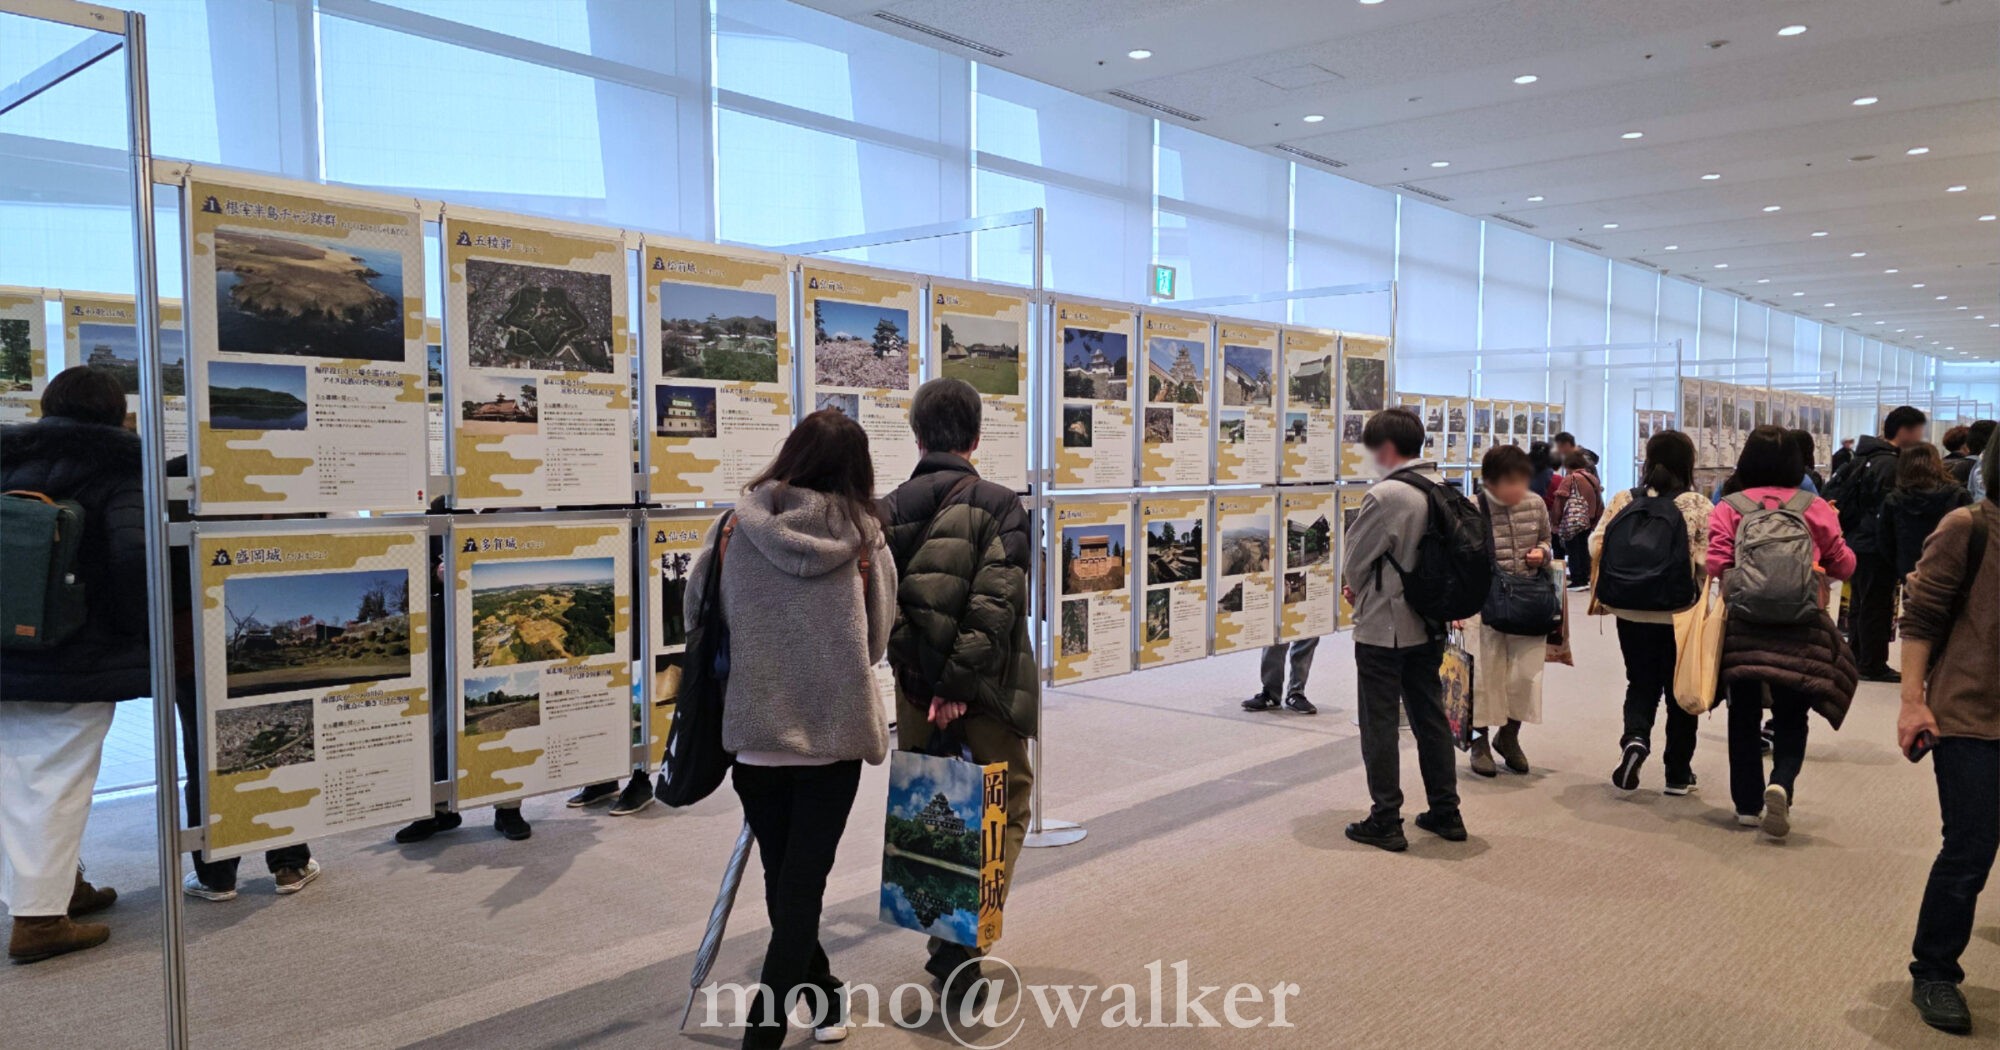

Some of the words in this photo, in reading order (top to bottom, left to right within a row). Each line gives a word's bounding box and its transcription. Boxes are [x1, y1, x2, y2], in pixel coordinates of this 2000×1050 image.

[225, 200, 337, 228] 根室半島チャシ跡群
[475, 235, 512, 249] 五稜郭
[483, 537, 517, 551] 多賀城
[235, 548, 282, 563] 盛岡城
[980, 769, 1008, 918] 岡山城
